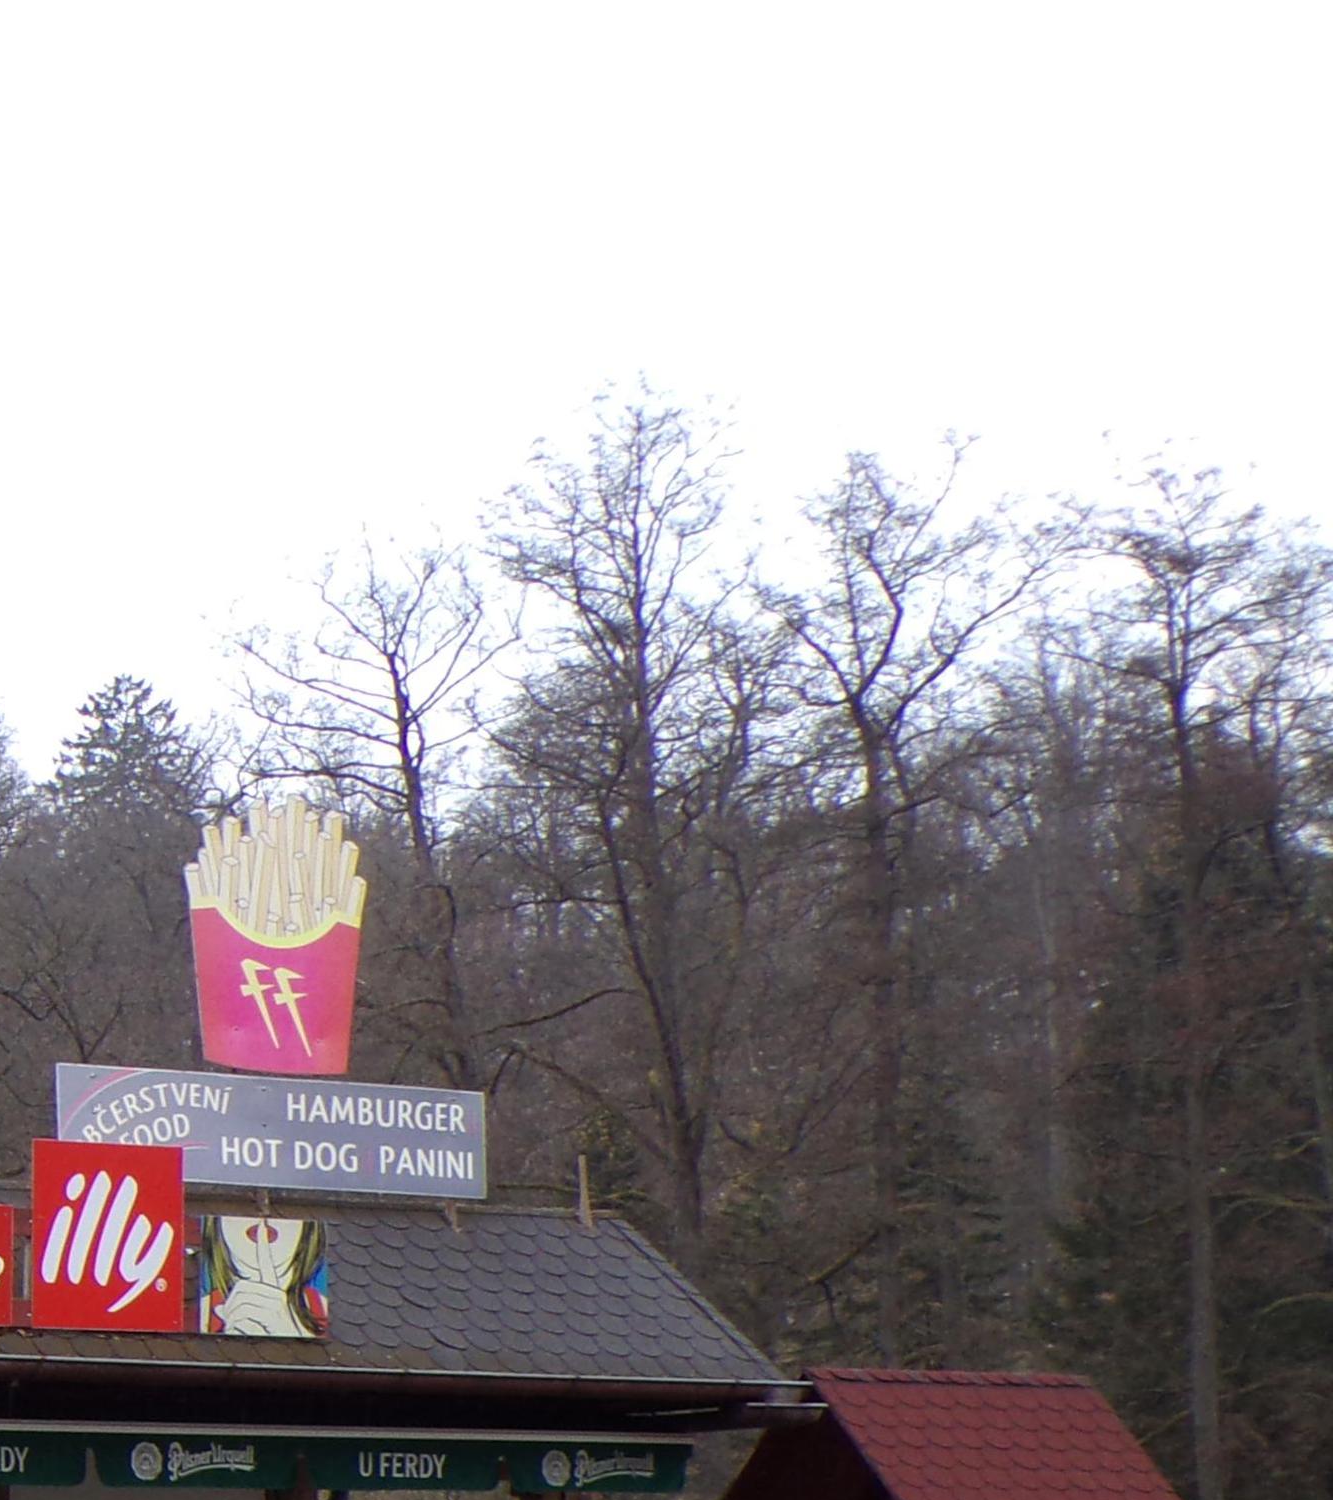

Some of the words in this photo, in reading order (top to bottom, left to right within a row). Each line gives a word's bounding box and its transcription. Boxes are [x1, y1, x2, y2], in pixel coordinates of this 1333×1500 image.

[82, 1082, 233, 1143] BČERSTVENÍ
[287, 1092, 467, 1134] HAMBURGER
[221, 1136, 283, 1168] HOT
[293, 1140, 359, 1174] DOG
[379, 1145, 474, 1180] PANINI
[41, 1170, 174, 1313] illy
[358, 1451, 373, 1477] U
[380, 1452, 448, 1479] FERDY
